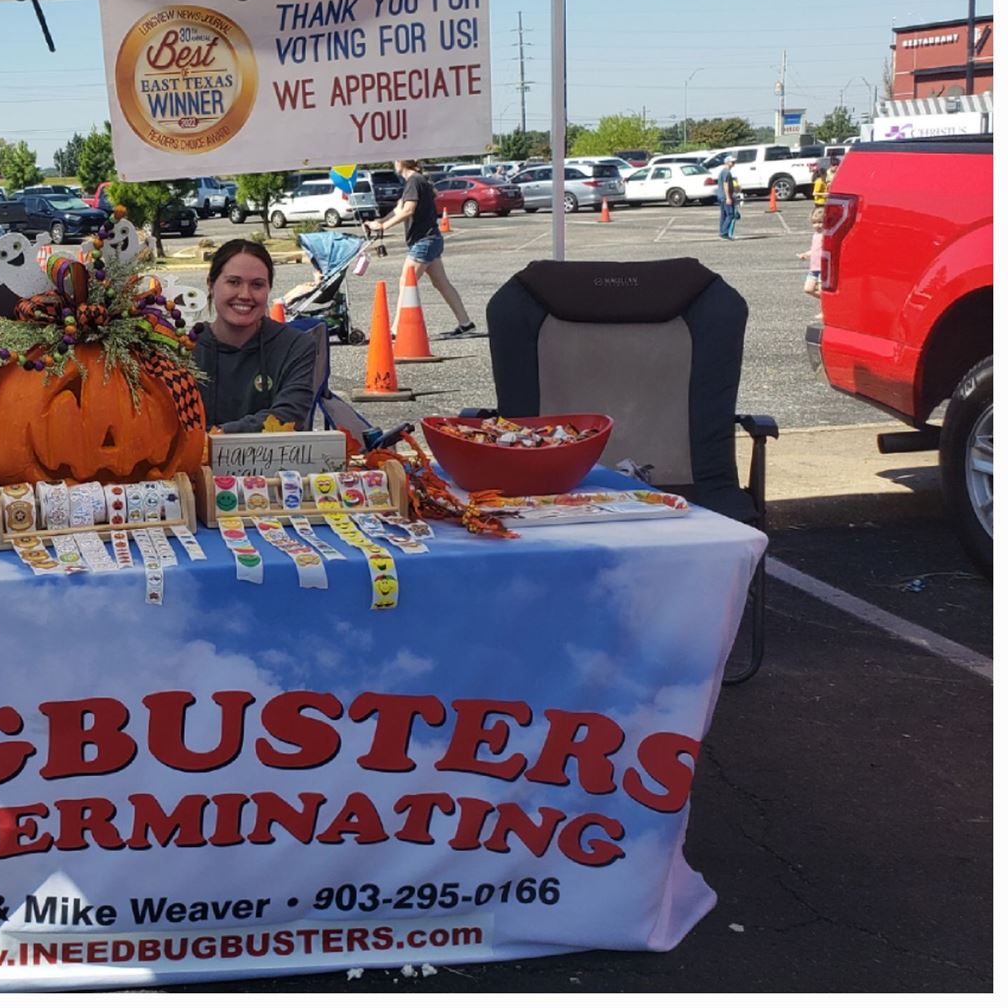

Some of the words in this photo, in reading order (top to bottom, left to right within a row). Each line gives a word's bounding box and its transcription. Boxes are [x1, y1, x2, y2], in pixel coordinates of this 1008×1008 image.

[139, 10, 174, 35] LONGVIEW
[147, 29, 219, 70] Best
[275, 28, 366, 65] VOTING
[379, 22, 426, 57] FOR
[440, 17, 479, 51] US!
[902, 33, 958, 48] RESTAURANT
[141, 78, 180, 93] EAST
[183, 75, 233, 91] TEXAS
[181, 68, 190, 77] OF
[273, 78, 316, 112] WE
[330, 64, 482, 107] APPRECIATE
[147, 89, 224, 118] WINNER
[180, 139, 205, 150] CHOICE
[206, 126, 230, 145] AWARD
[350, 108, 409, 144] YOU!
[25, 896, 117, 926] Mike
[131, 892, 271, 925] Weaver
[313, 877, 561, 912] 903-295-0166
